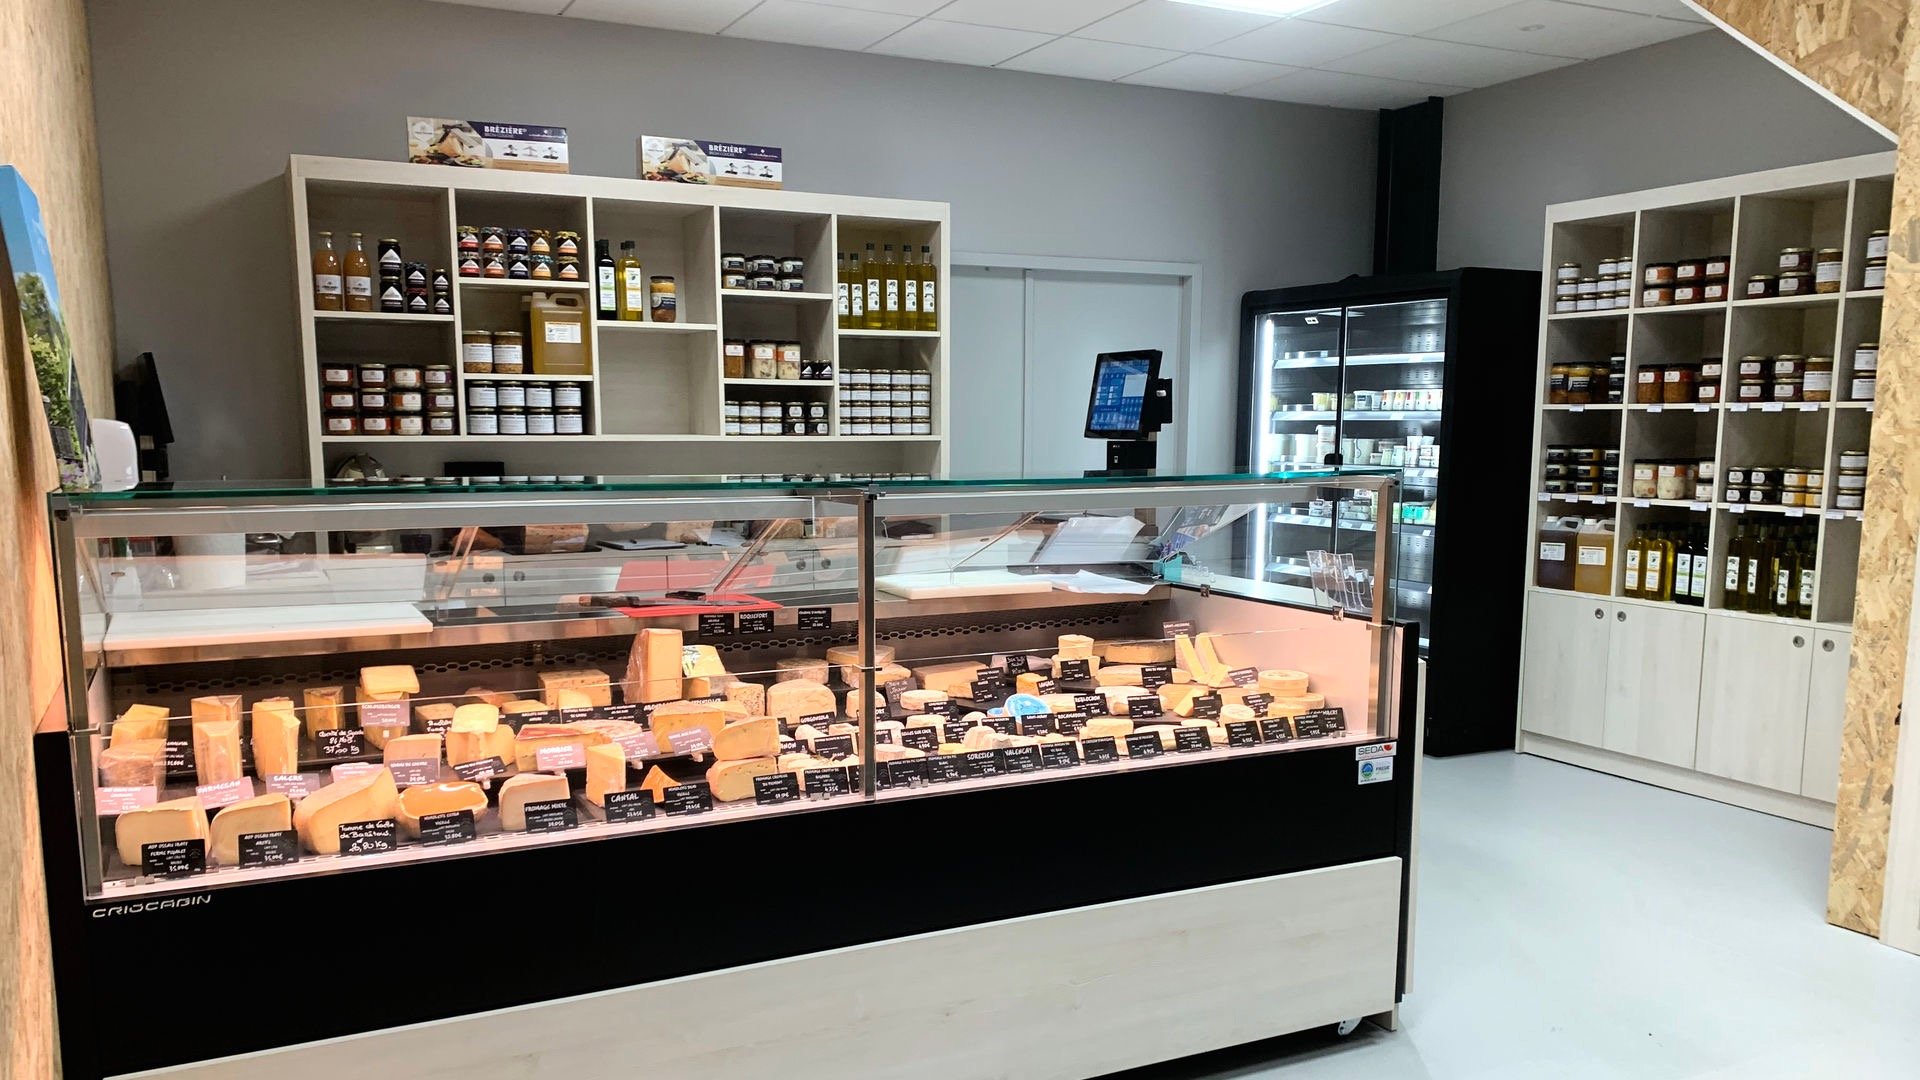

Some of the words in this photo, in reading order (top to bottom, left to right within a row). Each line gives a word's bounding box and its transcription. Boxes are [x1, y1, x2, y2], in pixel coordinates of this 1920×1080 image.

[1358, 745, 1384, 756] SEDA
[610, 793, 640, 803] CANTAL
[525, 804, 551, 812] FROMAGE
[92, 894, 212, 919] CRIOCABIN
